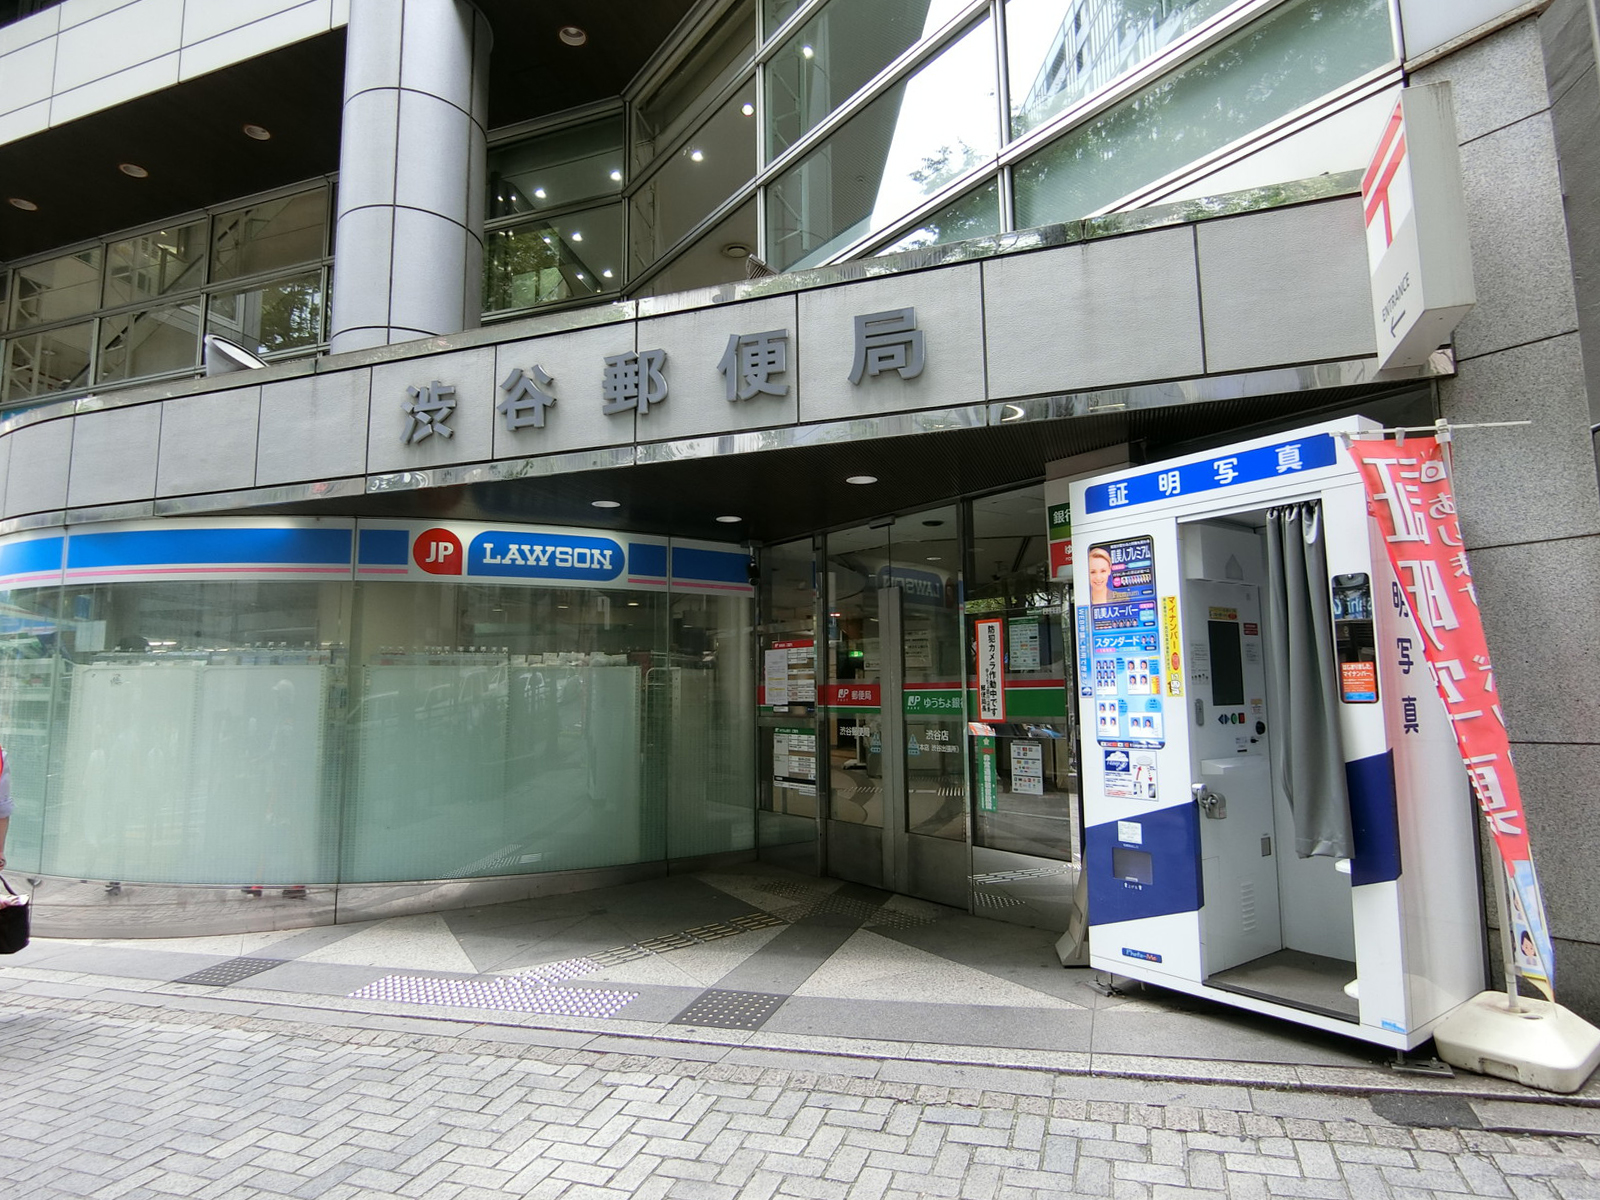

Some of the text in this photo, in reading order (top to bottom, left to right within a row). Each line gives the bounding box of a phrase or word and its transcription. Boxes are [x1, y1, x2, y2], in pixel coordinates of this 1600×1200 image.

[1382, 271, 1410, 322] ENTRANCE
[401, 306, 926, 445] 渋谷郵便局
[1108, 443, 1303, 506] 証明写真
[425, 541, 454, 563] JP
[483, 542, 613, 570] LAWSON
[1094, 605, 1139, 620] 肌美人スーパー
[1167, 596, 1179, 649] マイナンバー
[1095, 635, 1140, 648] スタンダード
[987, 625, 998, 717] 防犯カメラ作動中です
[926, 730, 949, 741] 渋谷店
